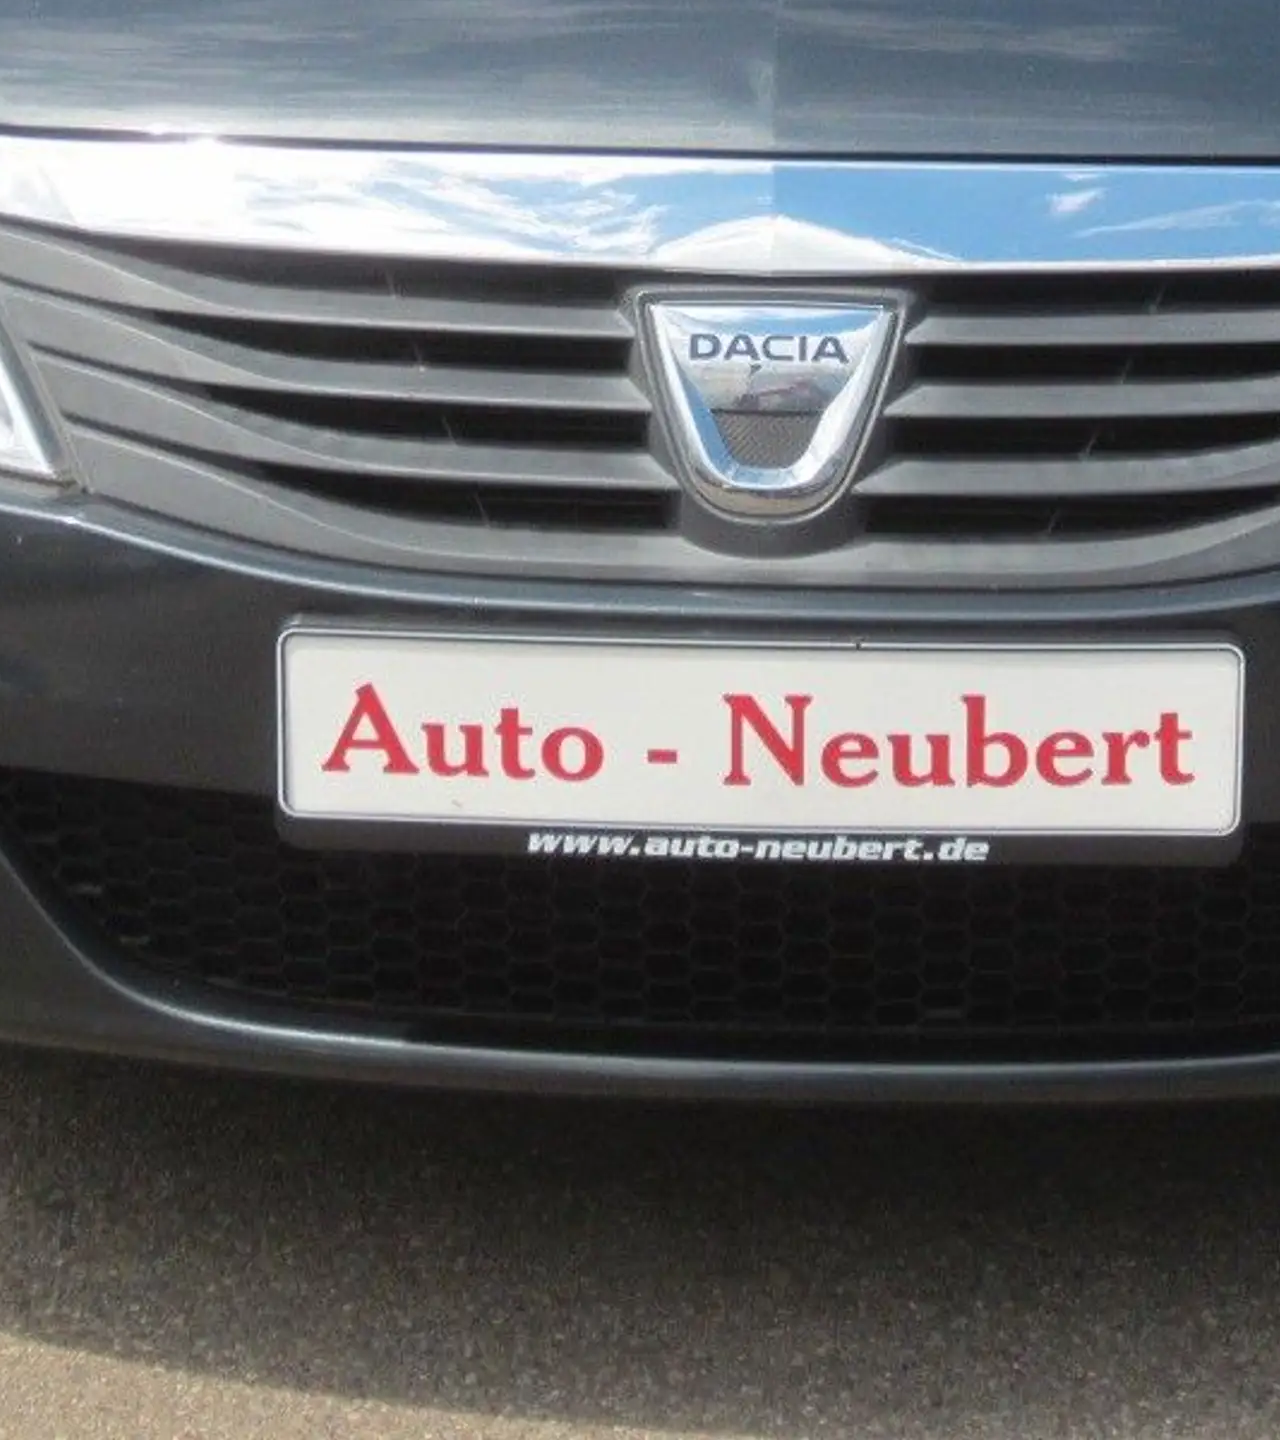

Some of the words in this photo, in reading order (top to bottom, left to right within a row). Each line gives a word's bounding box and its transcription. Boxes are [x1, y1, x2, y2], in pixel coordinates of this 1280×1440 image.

[688, 333, 850, 363] DACIA
[322, 682, 606, 781] Auto
[647, 747, 680, 765] -
[724, 691, 1194, 788] Neubert
[527, 831, 990, 861] www.auto-neubert.de
